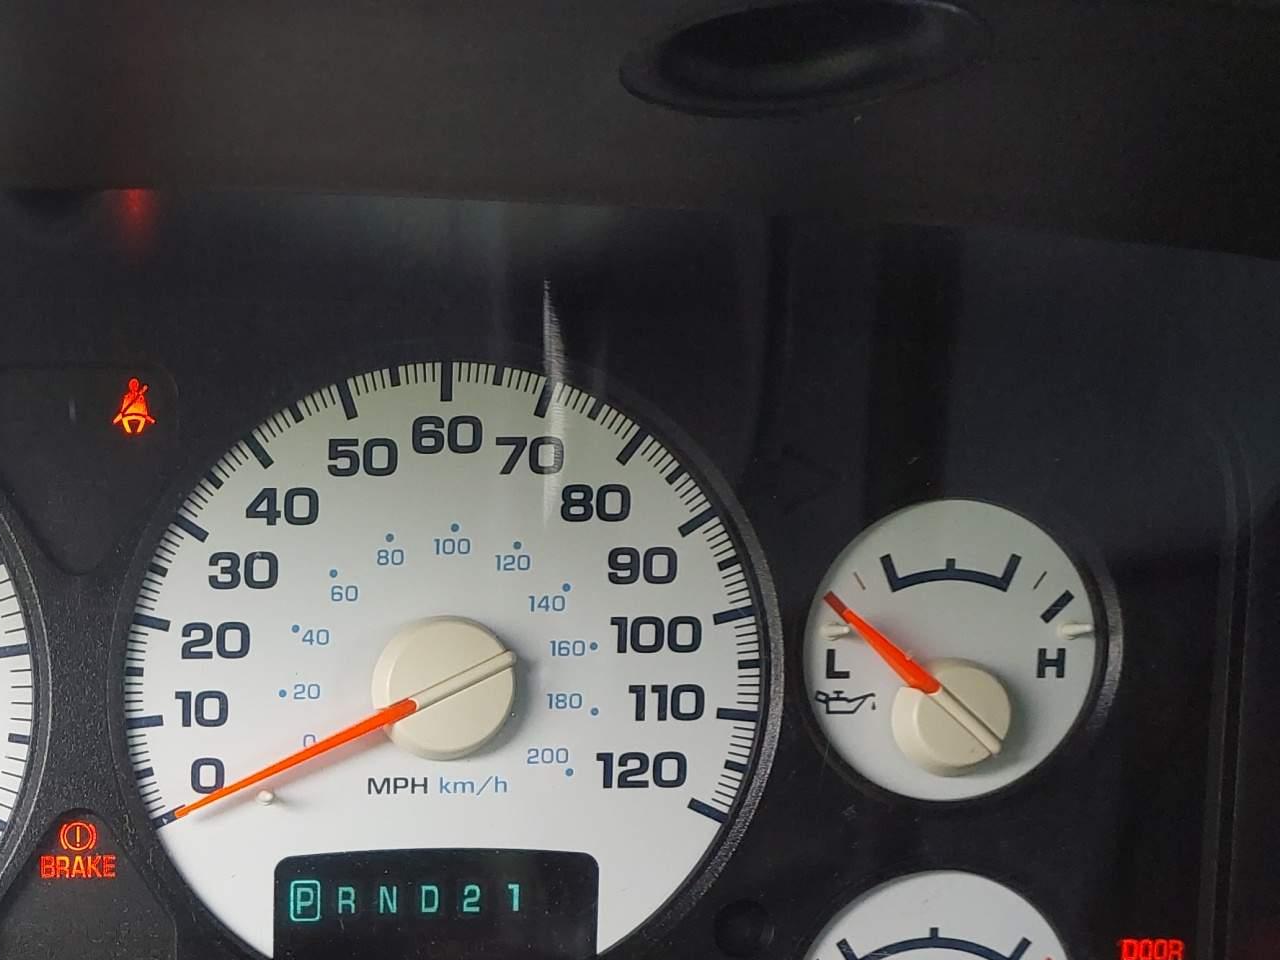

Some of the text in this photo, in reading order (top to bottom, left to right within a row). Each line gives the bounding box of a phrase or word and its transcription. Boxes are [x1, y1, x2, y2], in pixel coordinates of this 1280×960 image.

[412, 416, 482, 454] 60
[328, 438, 398, 476] 50
[496, 436, 564, 475] 70
[246, 488, 319, 525] 40
[561, 484, 630, 522] 80
[377, 549, 404, 565] 80
[434, 539, 470, 555] 100
[209, 552, 278, 589] 30
[496, 555, 530, 571] 120
[608, 547, 677, 584] 90
[331, 586, 358, 601] 60
[529, 596, 565, 612] 140
[182, 622, 250, 659] 20
[303, 629, 329, 645] 40
[550, 641, 585, 656] 160
[611, 616, 702, 653] 100
[826, 649, 850, 679] L
[1037, 648, 1066, 678] H
[294, 684, 320, 699] 20
[547, 693, 582, 709] 180
[629, 684, 704, 721] 110
[175, 691, 228, 727] 10
[527, 748, 568, 764] 200
[597, 752, 687, 788] 120
[191, 758, 225, 794] 0
[368, 776, 507, 795] MPH km/h
[40, 855, 116, 879] BRAKE
[297, 884, 519, 913] P R N D 2 1
